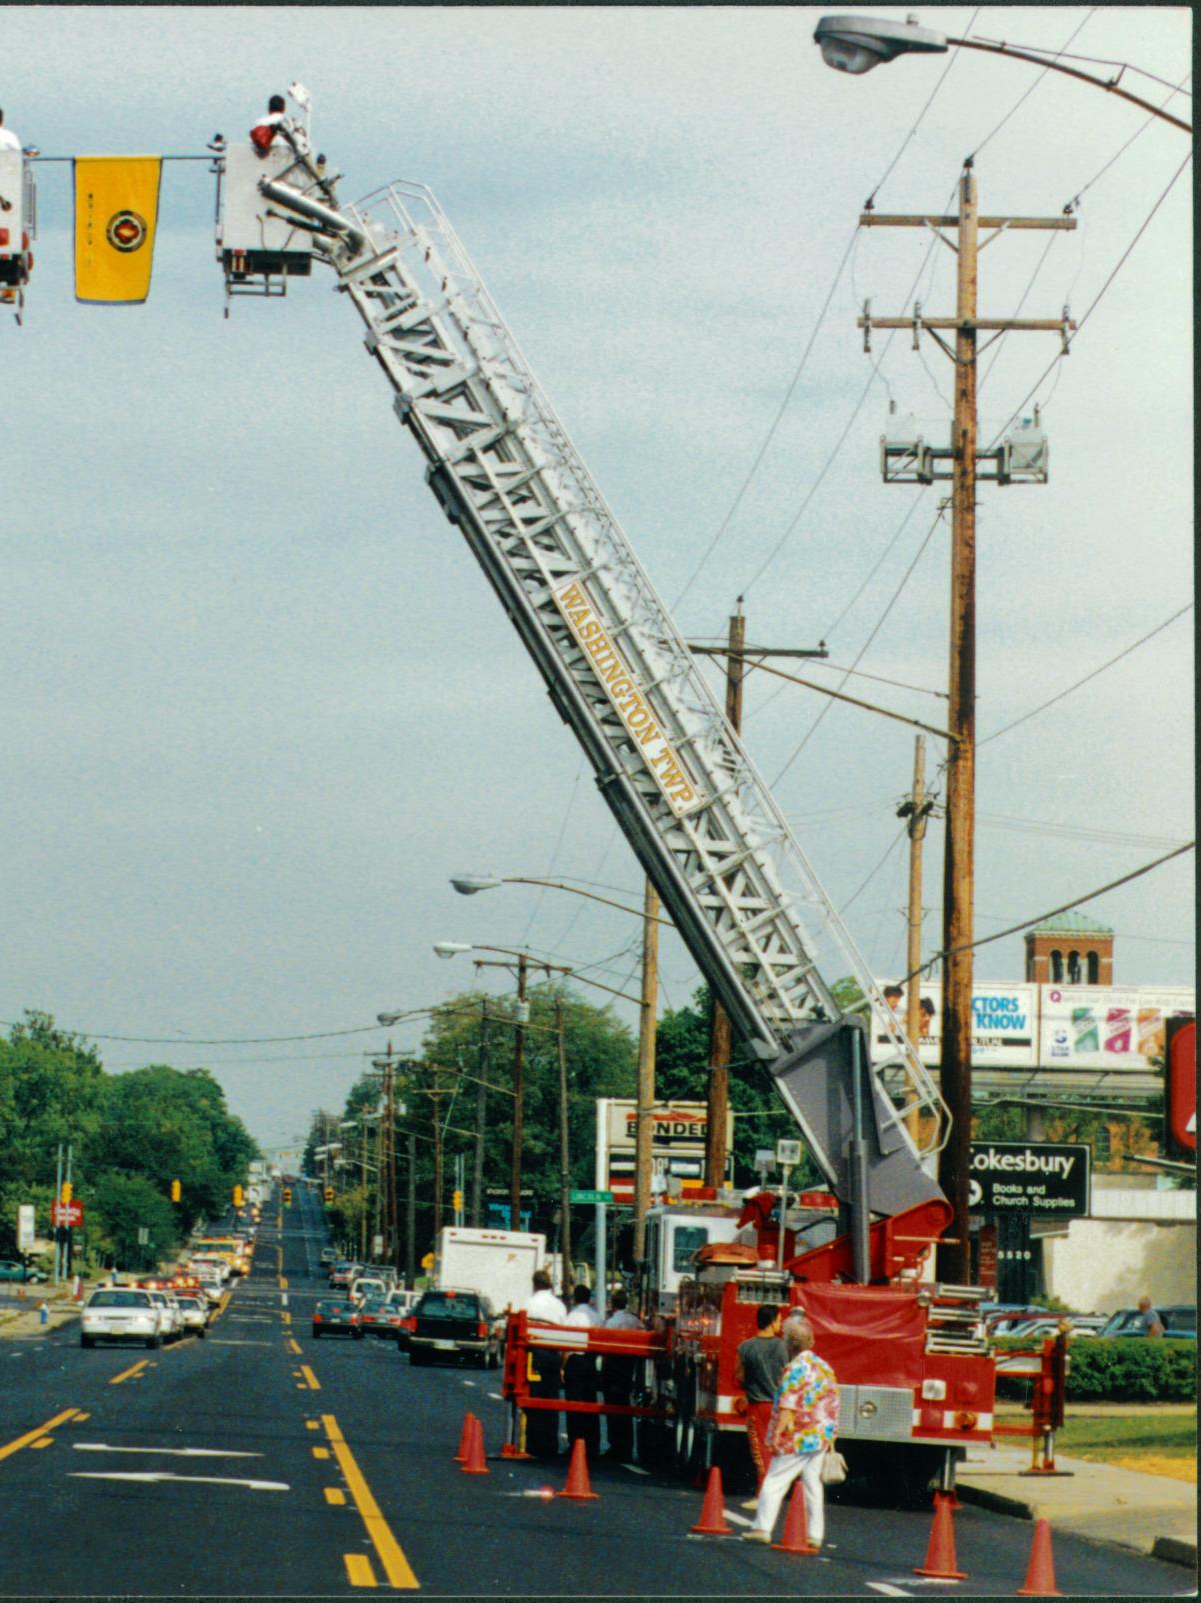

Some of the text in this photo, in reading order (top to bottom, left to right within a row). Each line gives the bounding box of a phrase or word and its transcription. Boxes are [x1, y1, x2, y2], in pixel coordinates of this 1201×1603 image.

[559, 583, 695, 812] WASHINGTON TWP.
[971, 996, 1019, 1013] CTORS
[976, 1013, 1027, 1030] KNOW
[626, 1121, 707, 1136] BNDE
[969, 1147, 1076, 1180] okesbury
[992, 1182, 1047, 1196] Books and
[992, 1195, 1077, 1210] Church Supplies
